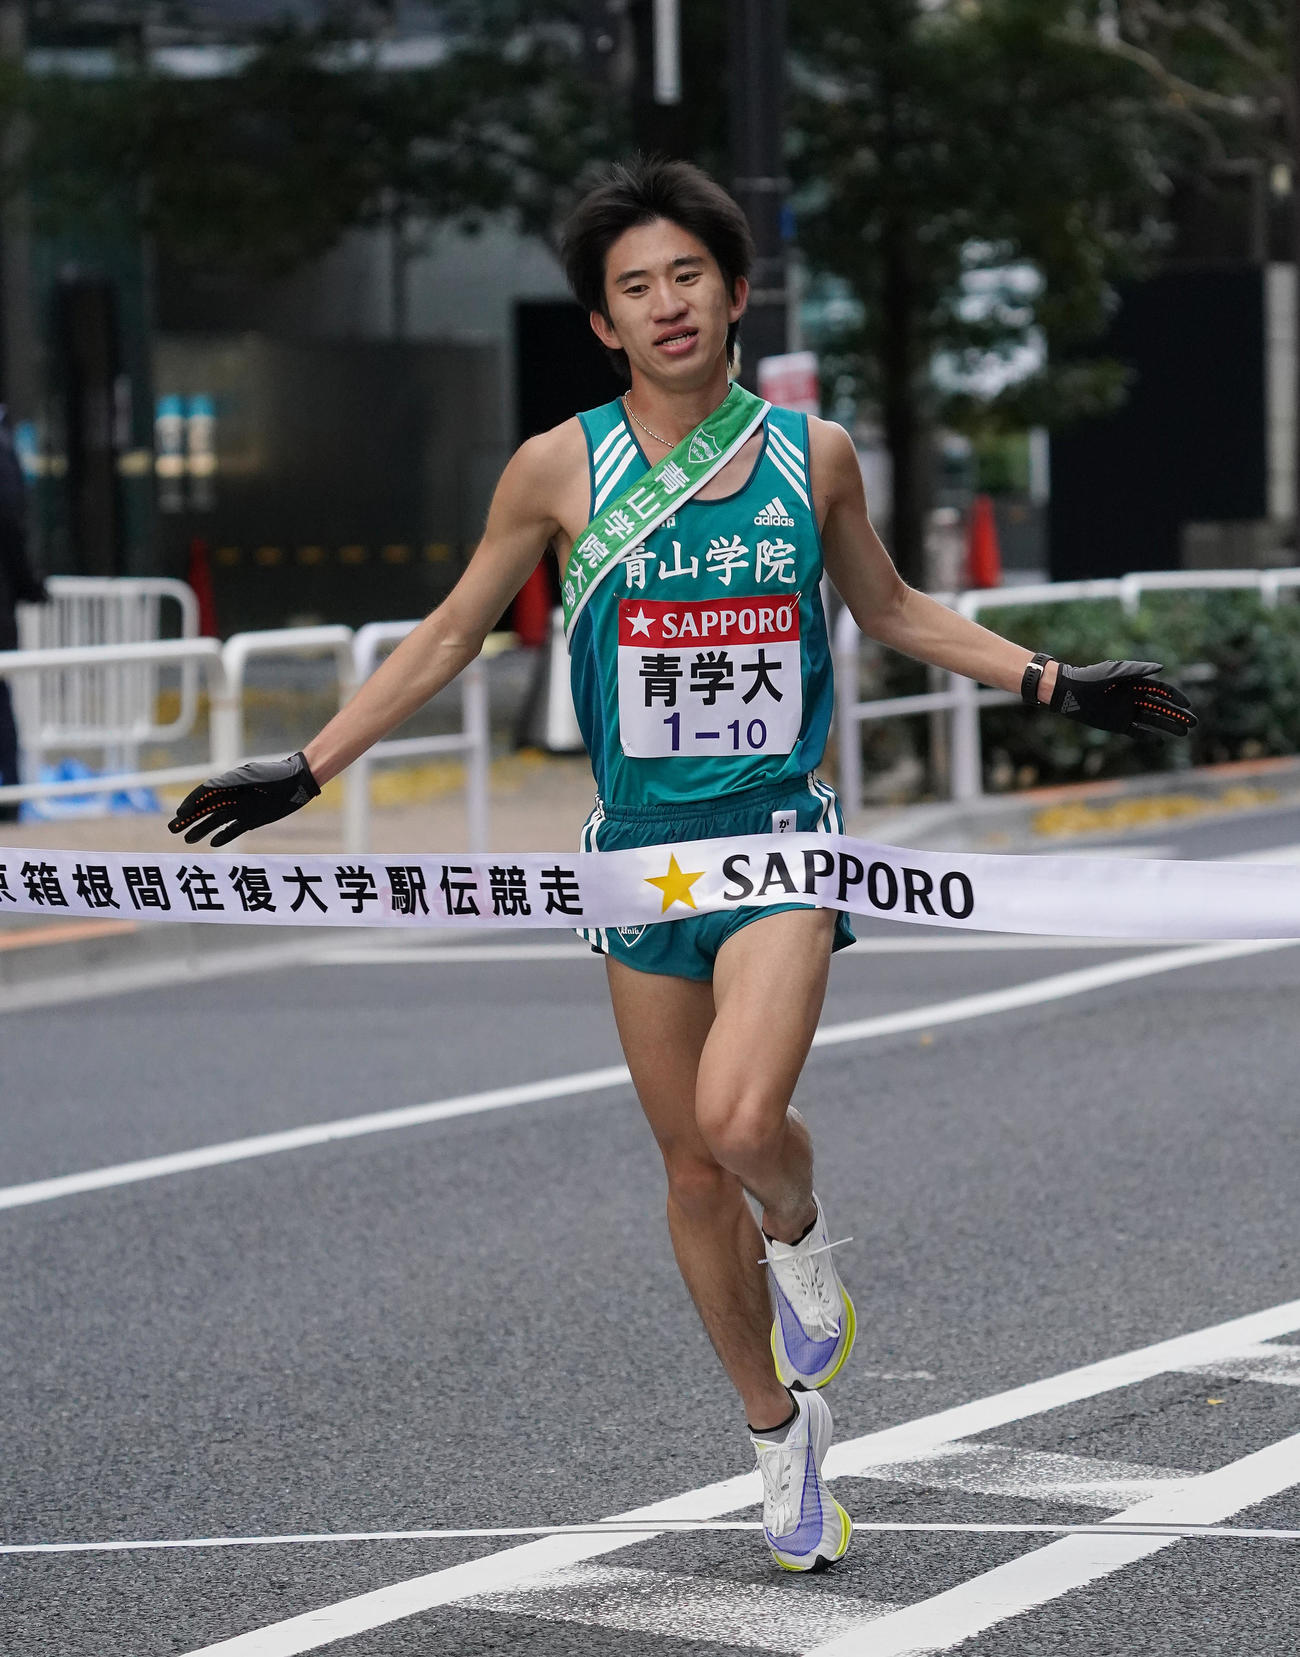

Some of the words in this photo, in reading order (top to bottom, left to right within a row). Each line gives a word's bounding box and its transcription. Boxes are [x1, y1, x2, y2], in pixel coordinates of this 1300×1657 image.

[753, 514, 795, 527] adidas
[618, 534, 797, 590] 青山学院
[662, 605, 793, 639] SAPPORO
[639, 648, 784, 708] 青学大
[663, 712, 767, 752] 1-10
[722, 849, 975, 919] SAPPORO
